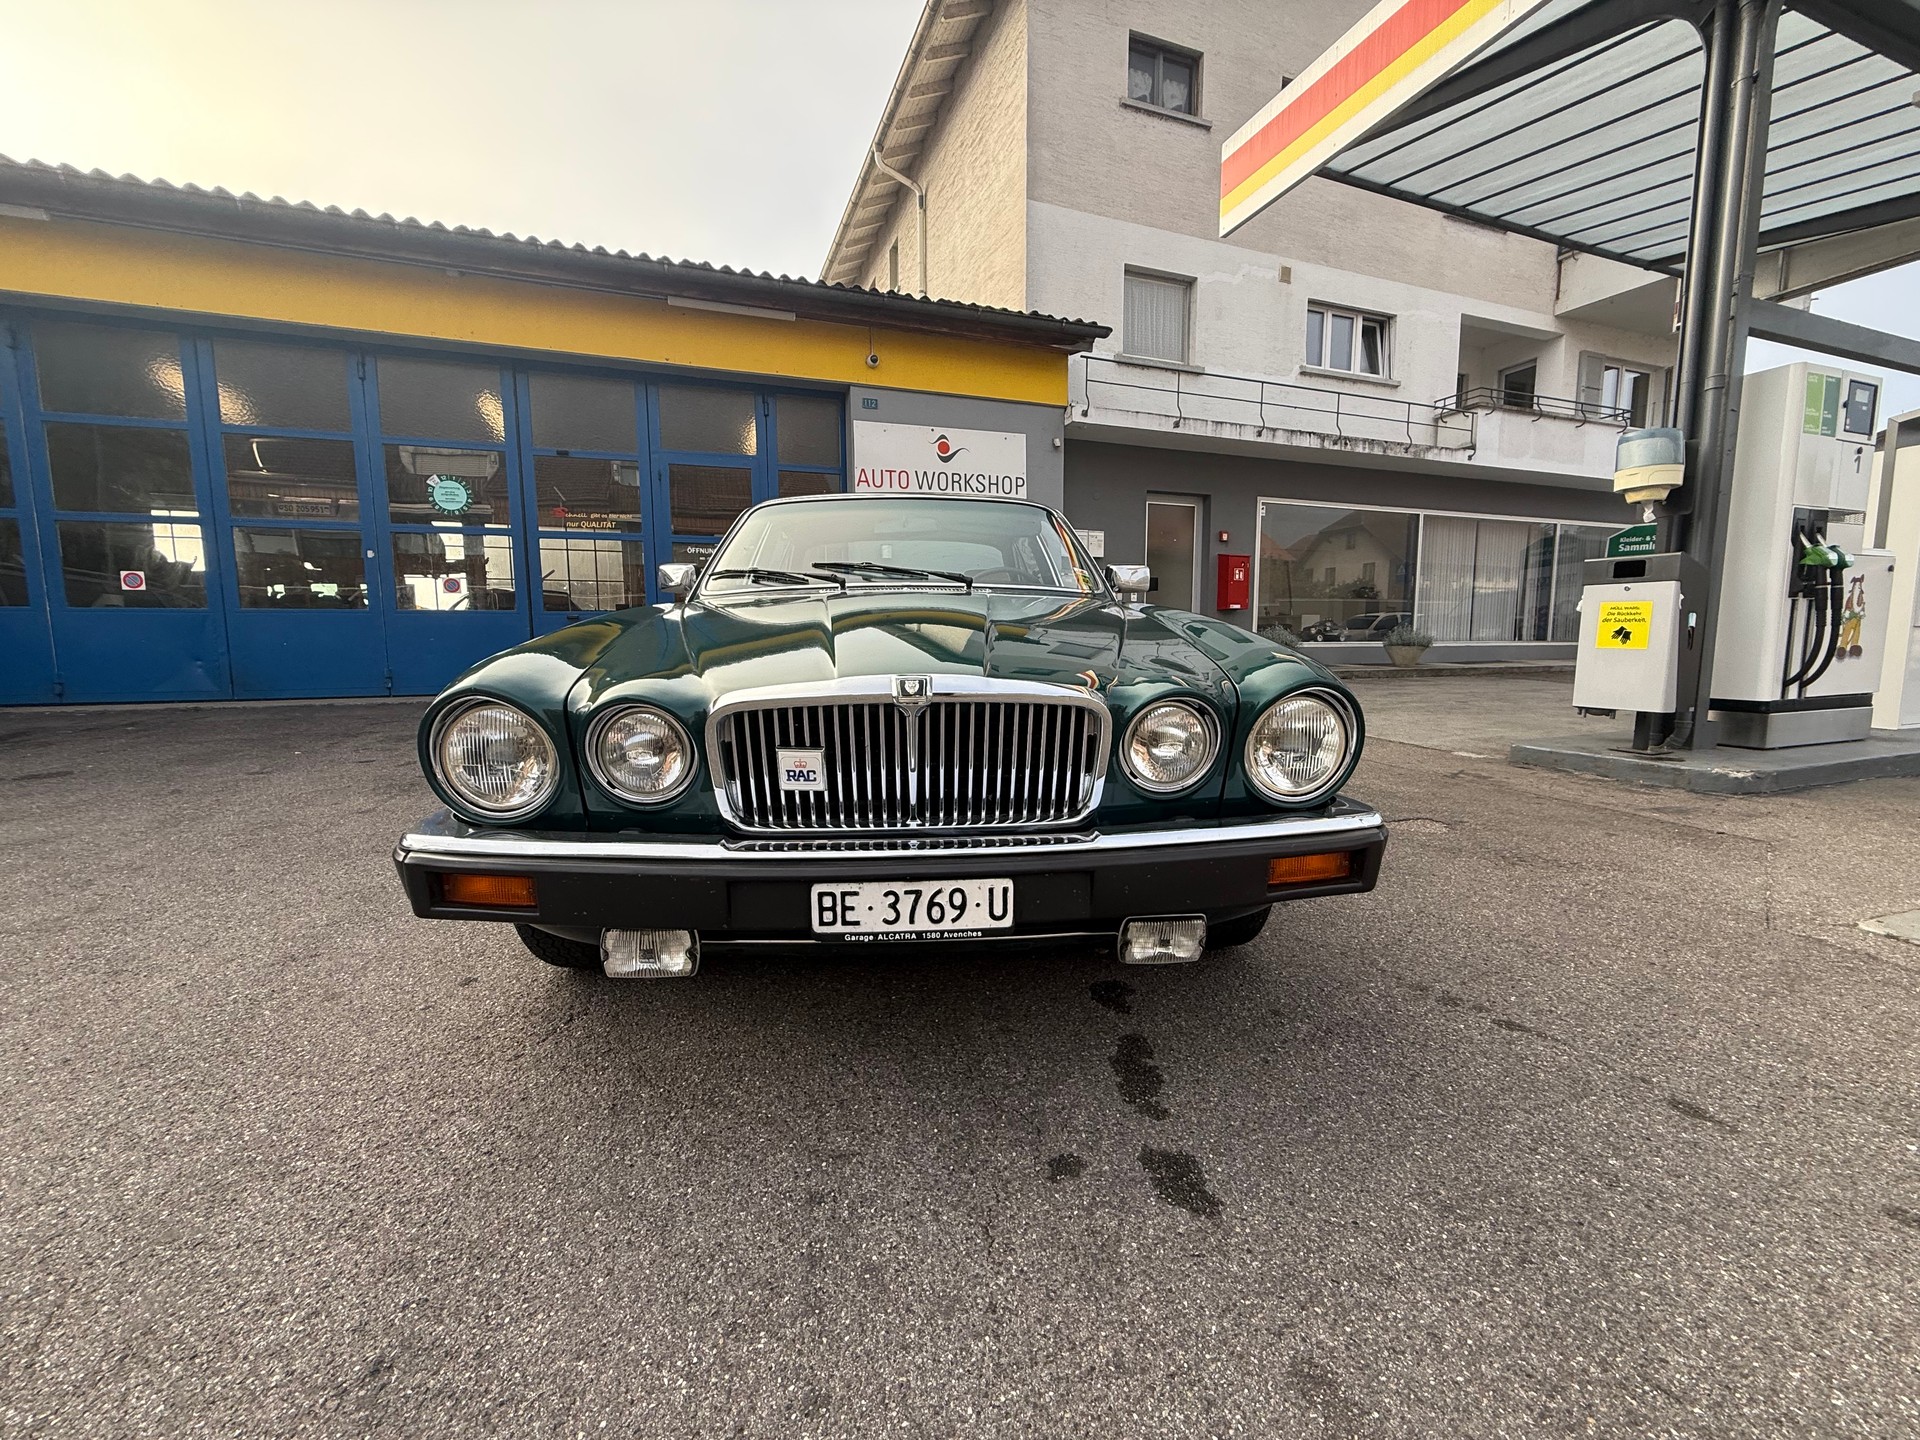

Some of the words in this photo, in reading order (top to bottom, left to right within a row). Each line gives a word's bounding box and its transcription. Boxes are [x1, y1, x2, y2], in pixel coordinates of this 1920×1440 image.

[864, 399, 877, 408] 112
[1854, 455, 1862, 474] 1
[856, 468, 910, 490] AUTO
[914, 470, 1026, 496] WORKSHOP
[580, 519, 616, 528] QUALITÄT
[686, 546, 715, 554] ÖFFNUN
[785, 769, 817, 782] RAC
[844, 933, 874, 942] Garage
[877, 933, 917, 941] ALCATRA
[943, 930, 982, 939] Avenches
